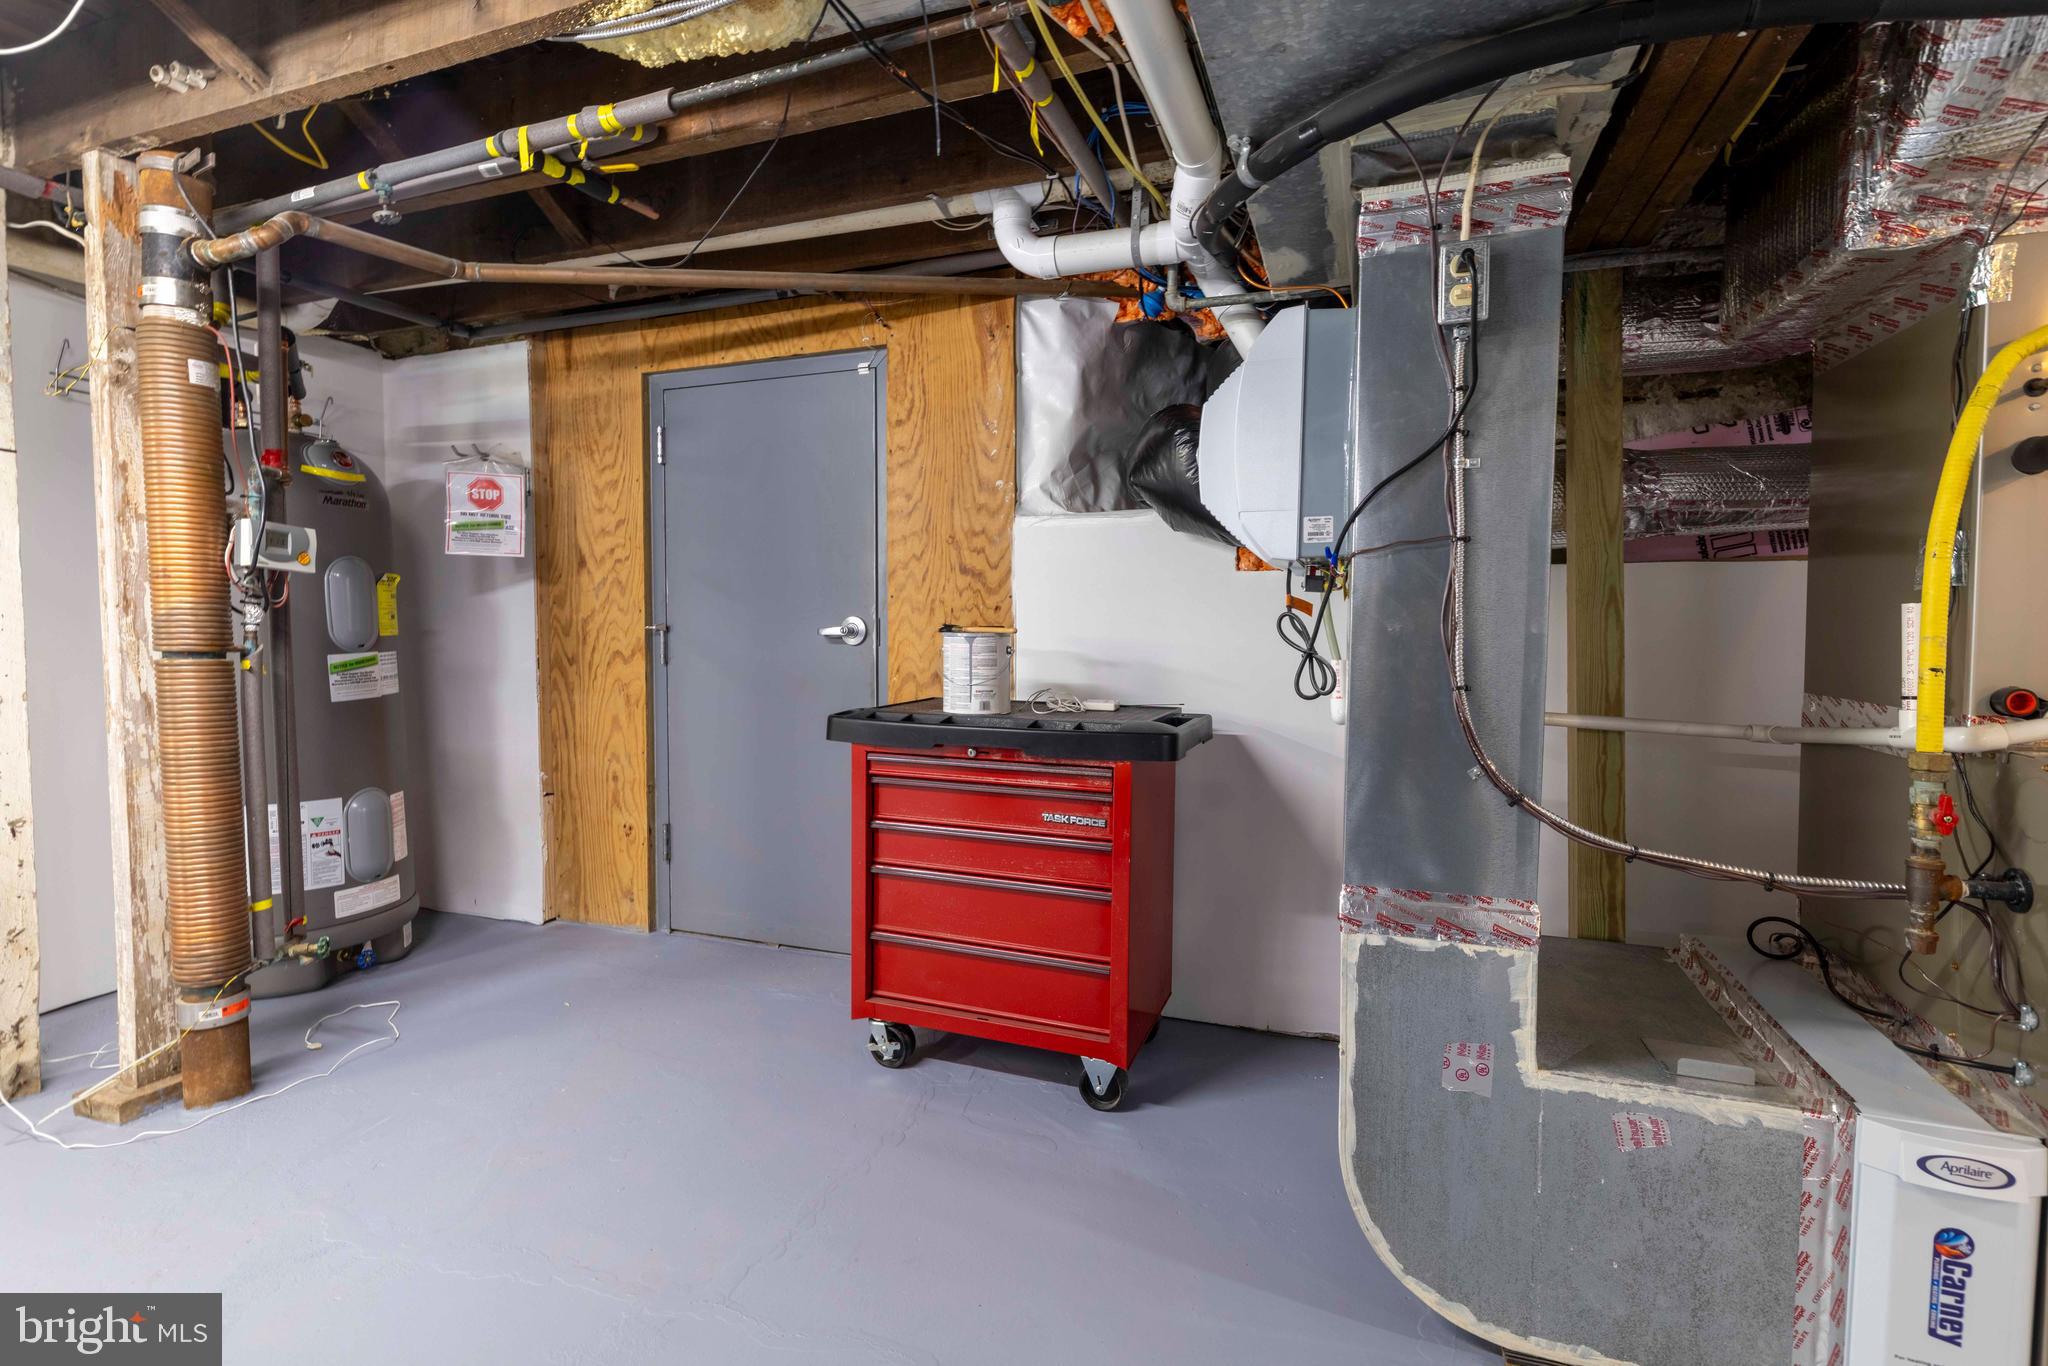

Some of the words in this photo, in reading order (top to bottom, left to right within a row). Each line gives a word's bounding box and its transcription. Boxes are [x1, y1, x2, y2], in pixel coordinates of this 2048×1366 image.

[471, 488, 500, 500] STOP
[322, 495, 367, 509] Marathon
[1042, 813, 1069, 824] TASK
[1070, 815, 1107, 828] FORCE
[1940, 1160, 1991, 1180] Aprilaire
[1934, 1257, 1973, 1348] Carney
